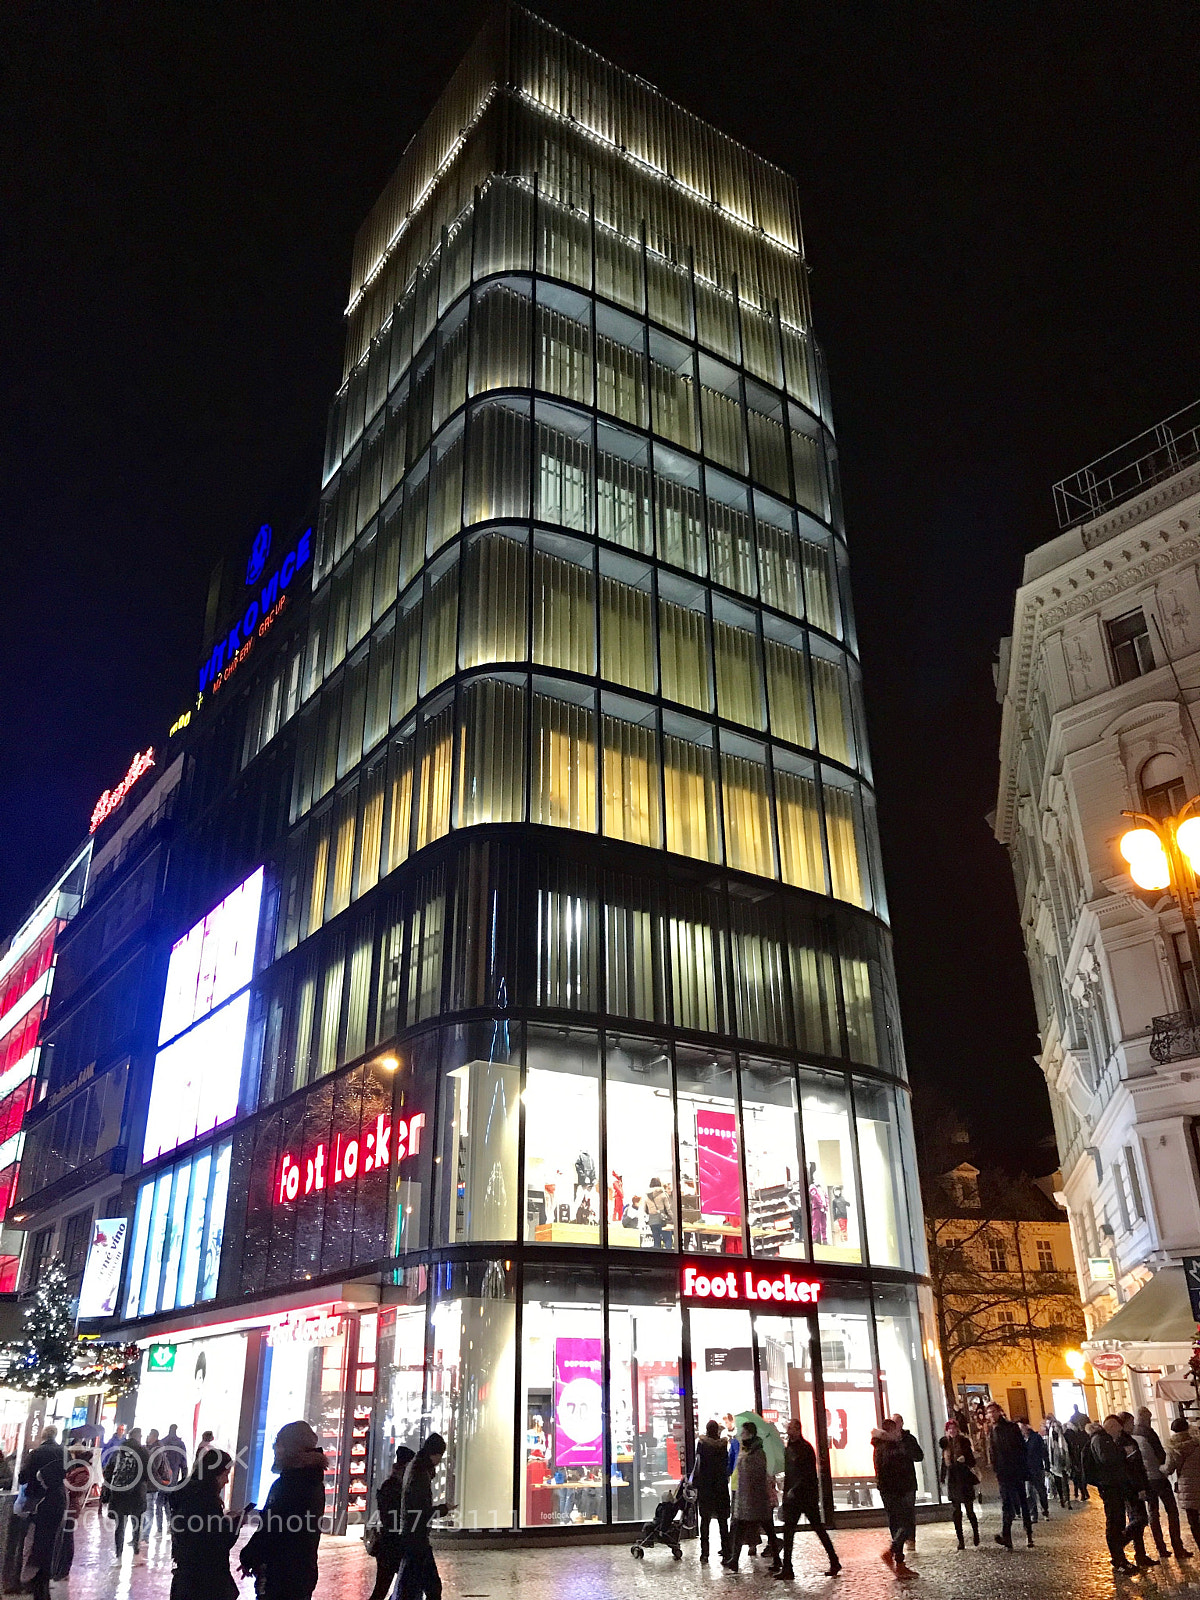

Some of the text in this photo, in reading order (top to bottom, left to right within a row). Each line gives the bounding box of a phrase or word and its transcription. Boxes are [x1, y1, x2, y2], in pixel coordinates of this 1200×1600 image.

[683, 1268, 821, 1303] Foot Locker
[30, 1410, 41, 1442] FAST
